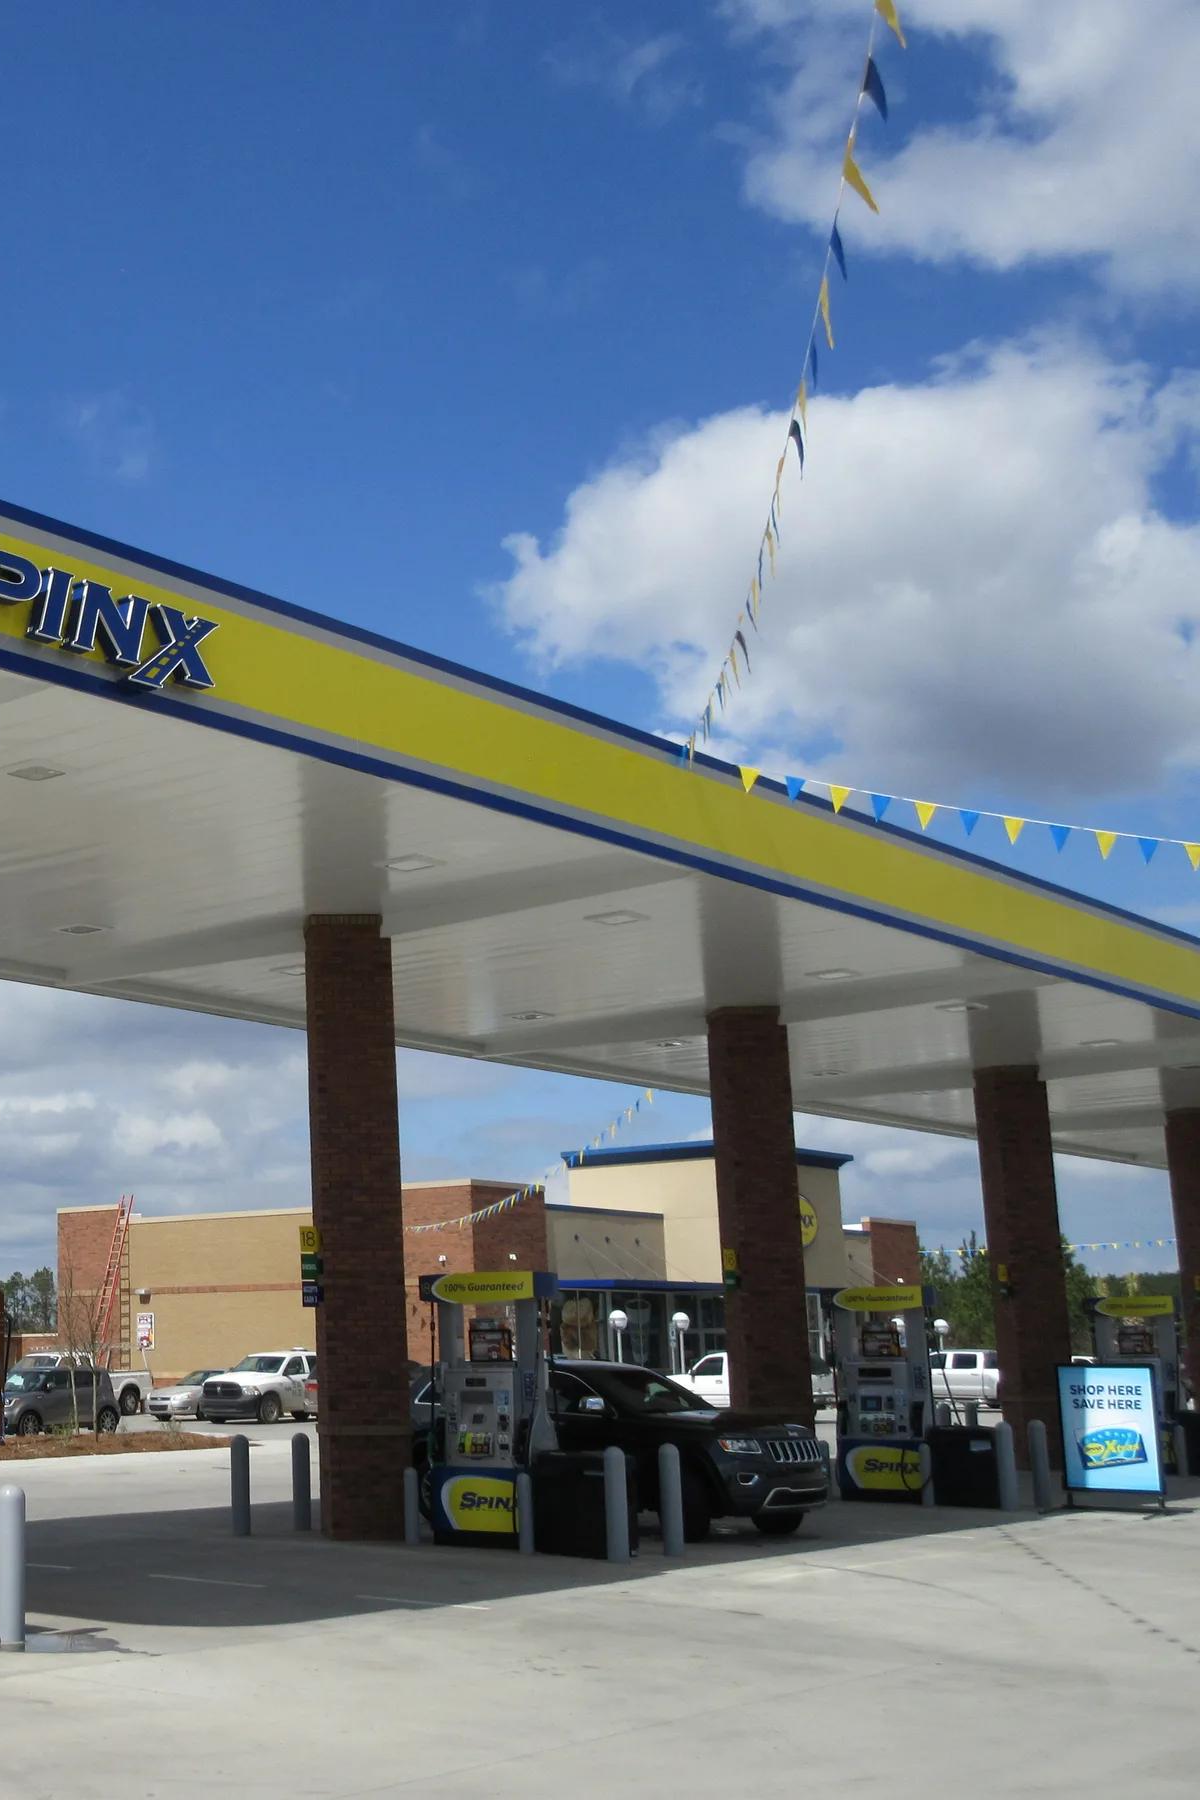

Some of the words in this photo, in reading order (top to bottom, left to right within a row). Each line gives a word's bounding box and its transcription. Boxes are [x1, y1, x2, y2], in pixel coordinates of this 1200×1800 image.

[302, 1231, 316, 1247] 18
[444, 1283, 466, 1293] 100%
[467, 1281, 525, 1292] Guaranteed
[1069, 1385, 1104, 1395] SHOP
[1107, 1385, 1143, 1396] HERE
[1072, 1399, 1104, 1410] SAVE
[1107, 1400, 1142, 1410] HERE
